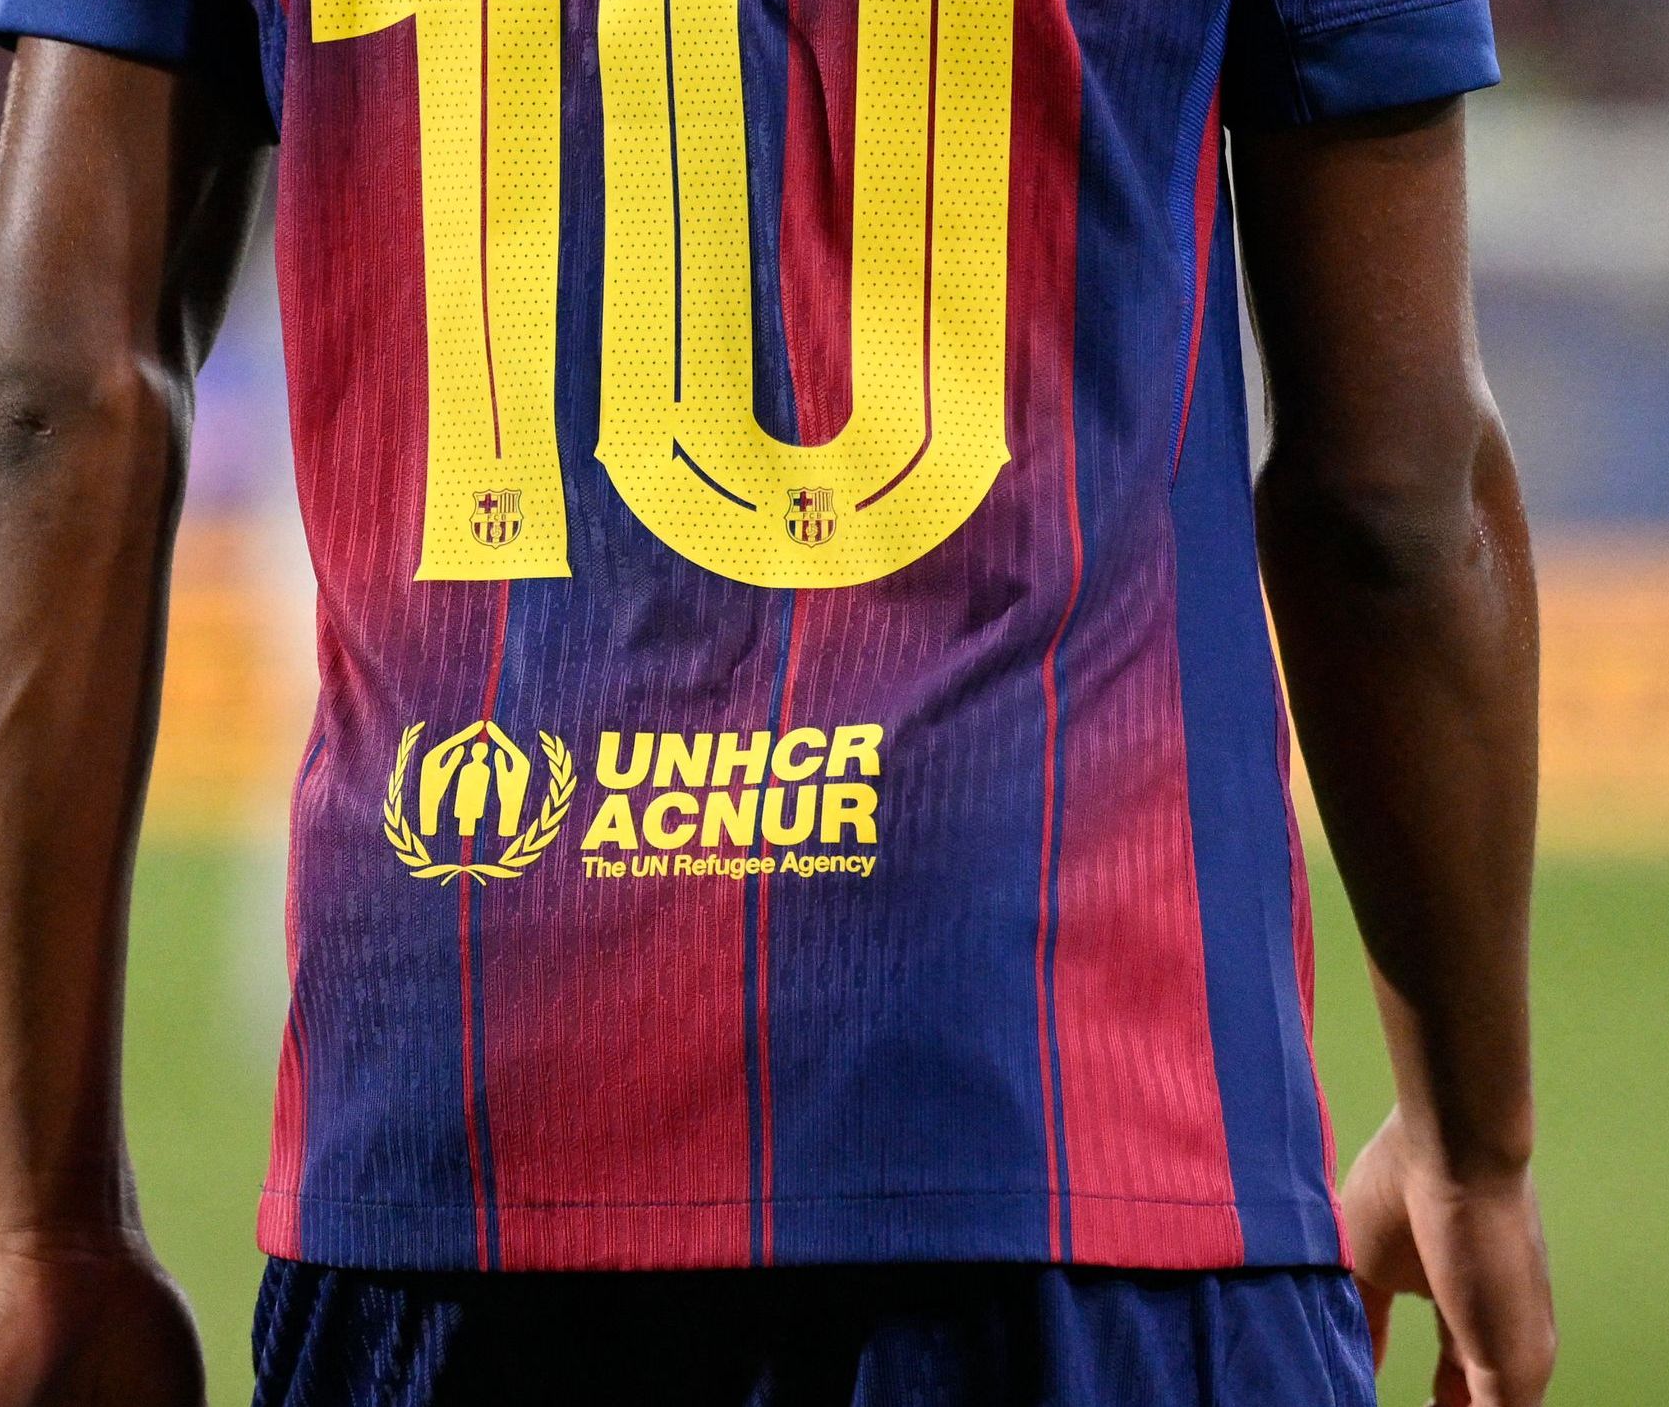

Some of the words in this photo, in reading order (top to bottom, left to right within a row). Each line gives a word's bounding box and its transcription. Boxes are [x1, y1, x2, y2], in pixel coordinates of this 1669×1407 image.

[596, 723, 884, 790] UNHCR
[580, 782, 880, 851] ACNUR
[581, 855, 628, 879] The
[630, 854, 670, 878] UN
[672, 853, 776, 881] Refugee
[779, 850, 877, 878] Agency
